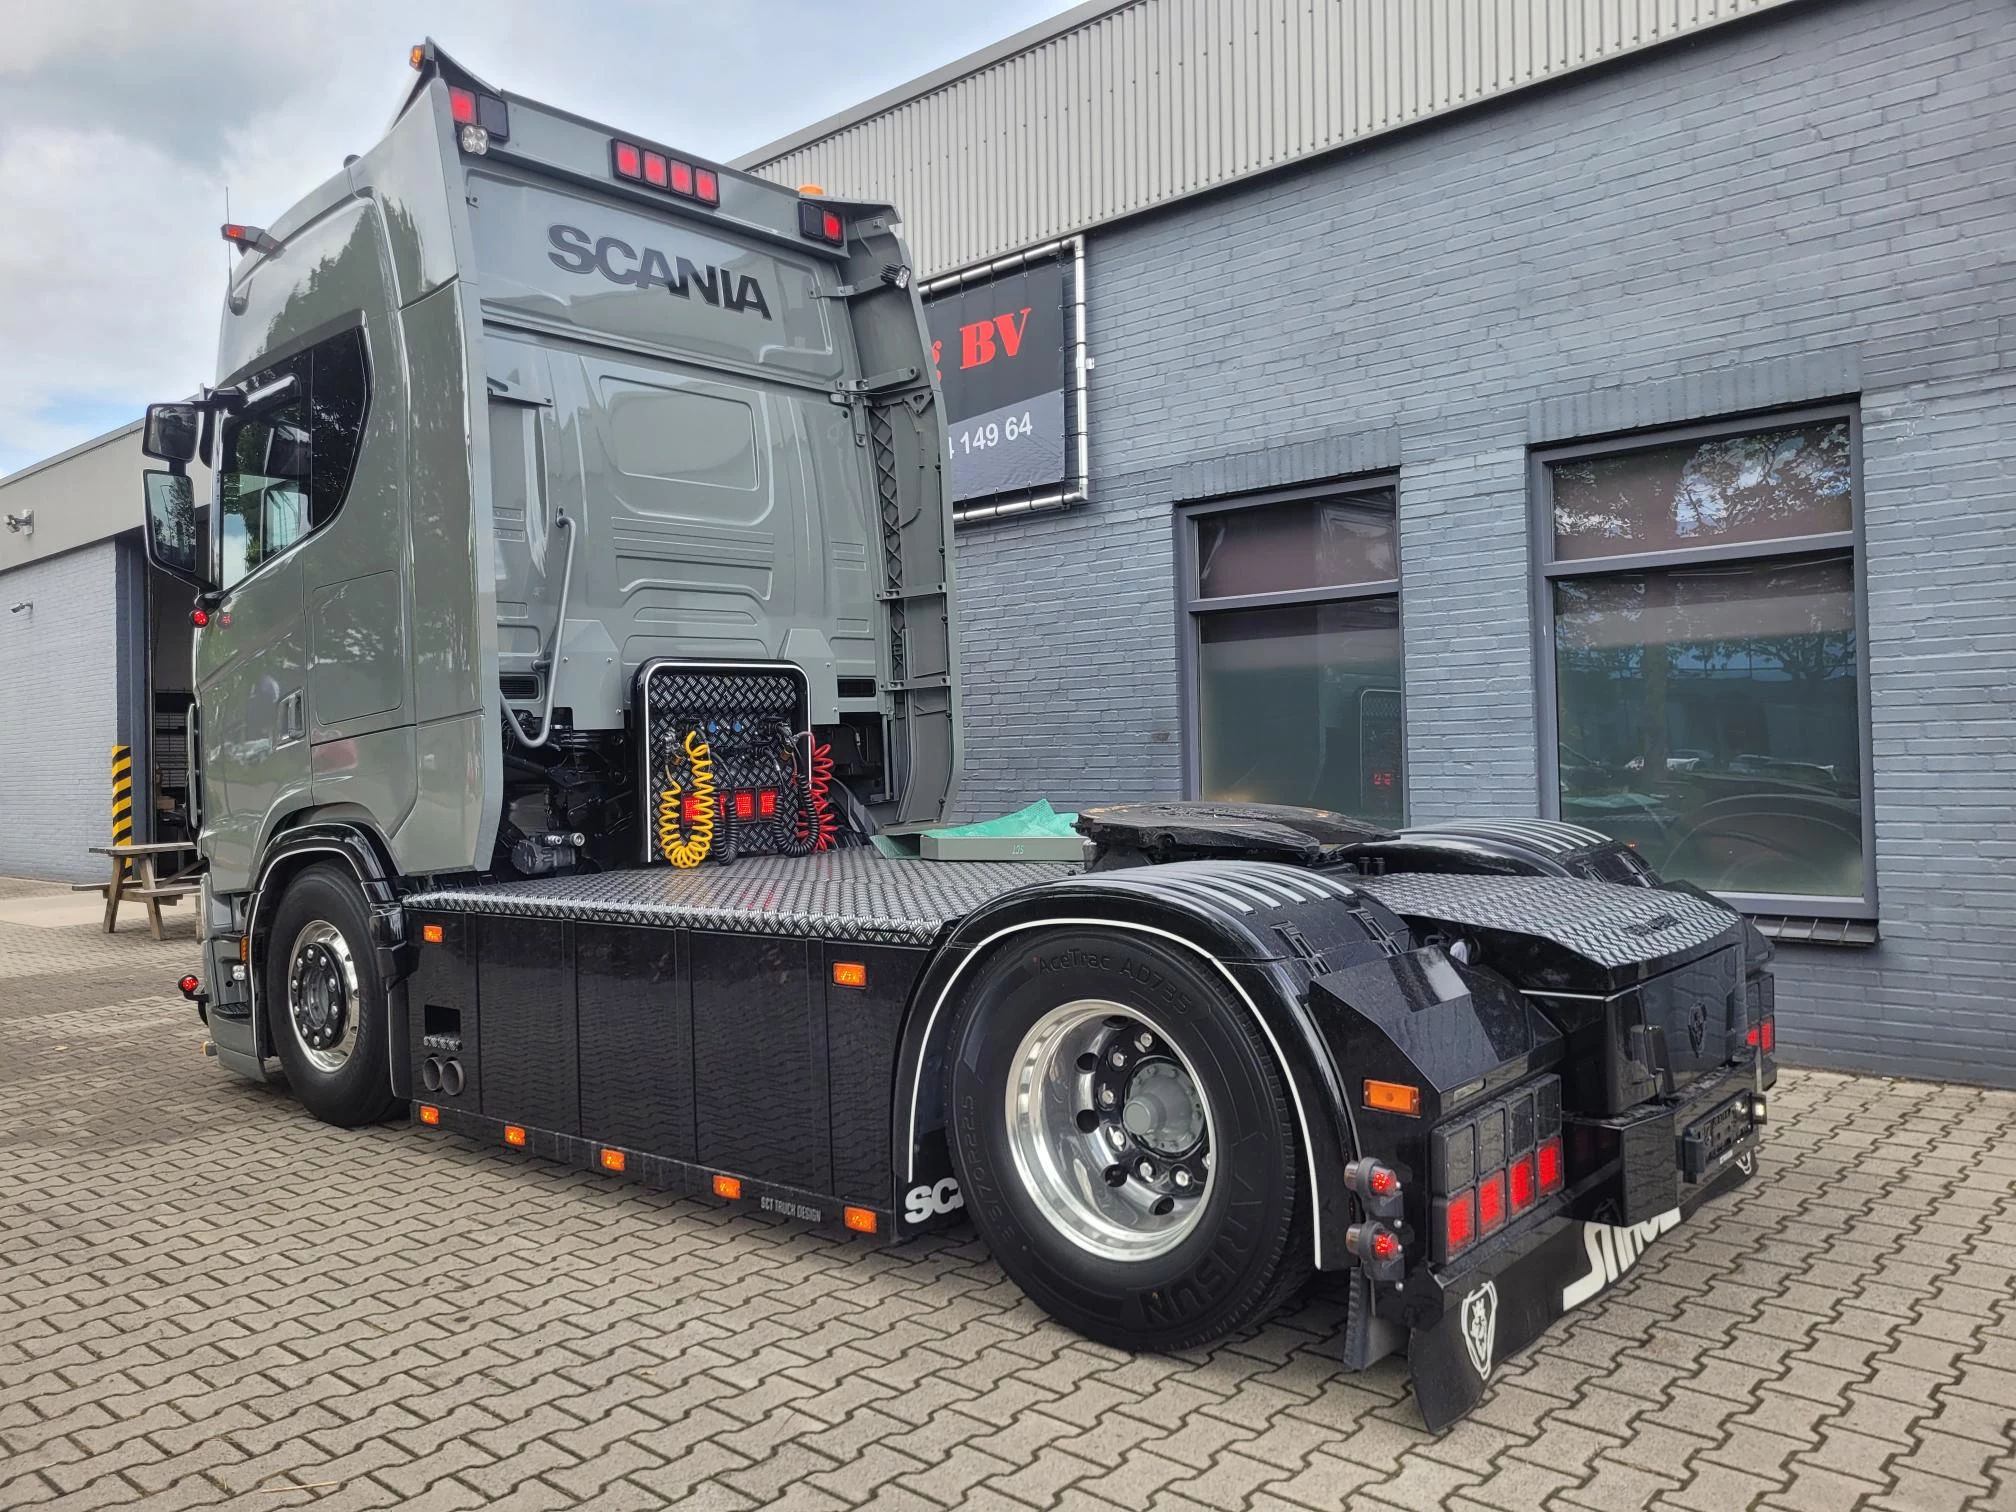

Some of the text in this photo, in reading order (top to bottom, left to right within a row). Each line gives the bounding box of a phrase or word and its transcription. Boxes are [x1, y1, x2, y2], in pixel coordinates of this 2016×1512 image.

[547, 224, 773, 321] SCANIA
[959, 307, 1032, 370] BV
[960, 423, 999, 455] 149
[1005, 411, 1033, 441] 64
[1039, 946, 1112, 975] AceTrac
[960, 1095, 1016, 1243] 35/70R22.5
[760, 1196, 821, 1222] SCT TRUCK DESIGN
[904, 1177, 965, 1224] SC
